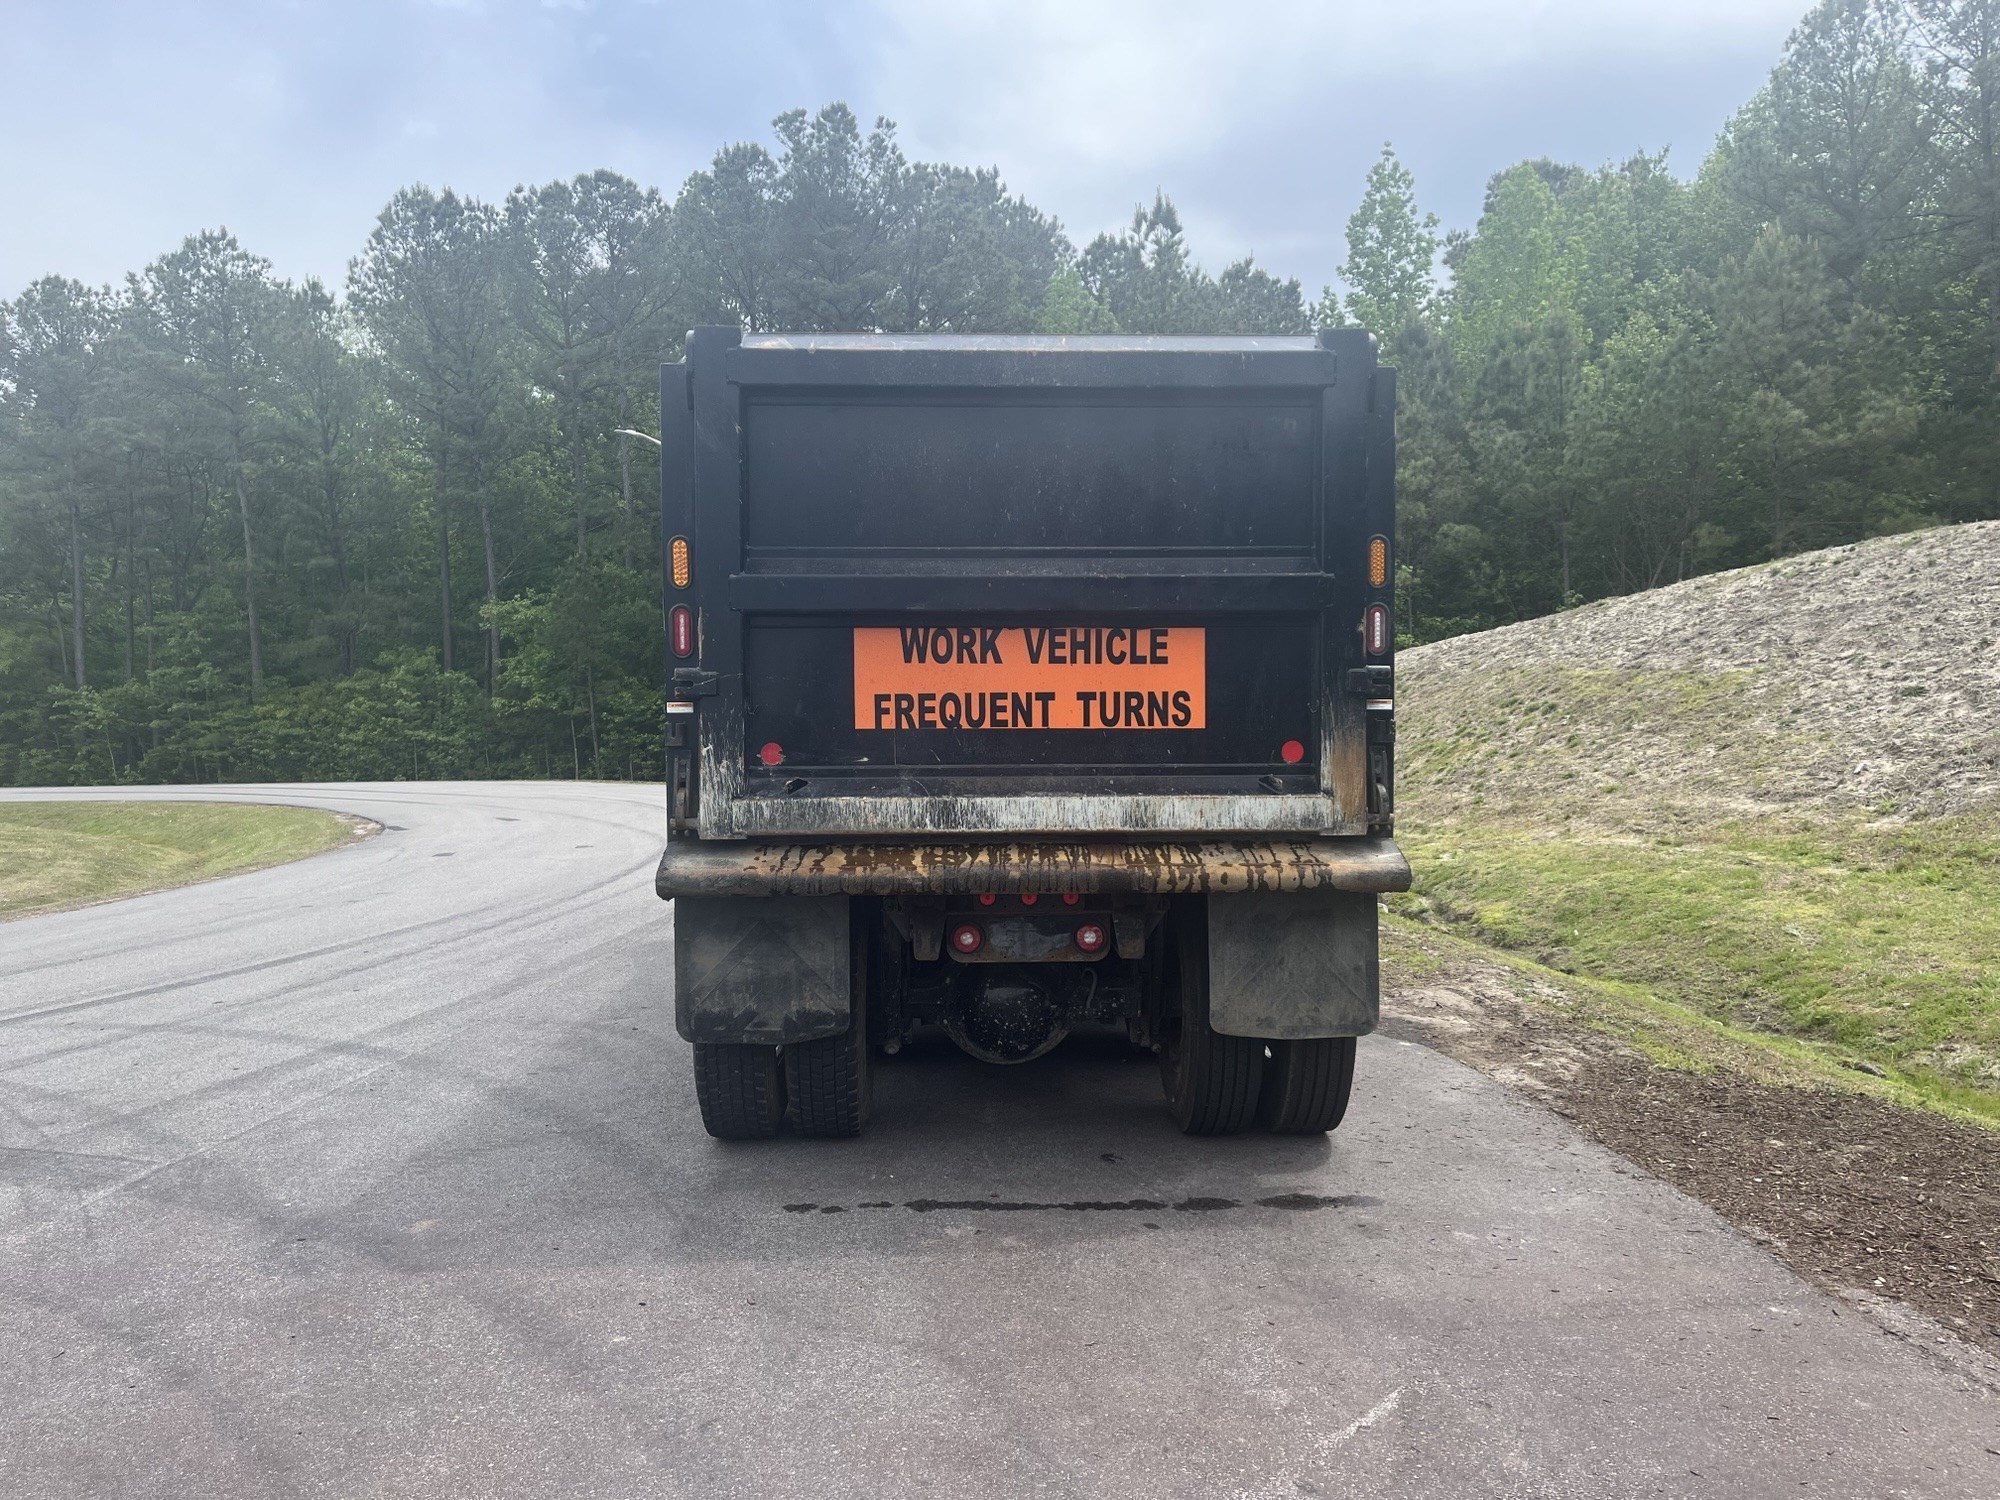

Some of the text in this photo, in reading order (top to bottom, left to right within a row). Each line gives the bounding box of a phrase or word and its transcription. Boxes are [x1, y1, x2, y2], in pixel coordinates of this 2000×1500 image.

[901, 628, 1168, 665] WORK VEHICLE
[874, 690, 1192, 730] FREQUENT TURNS
